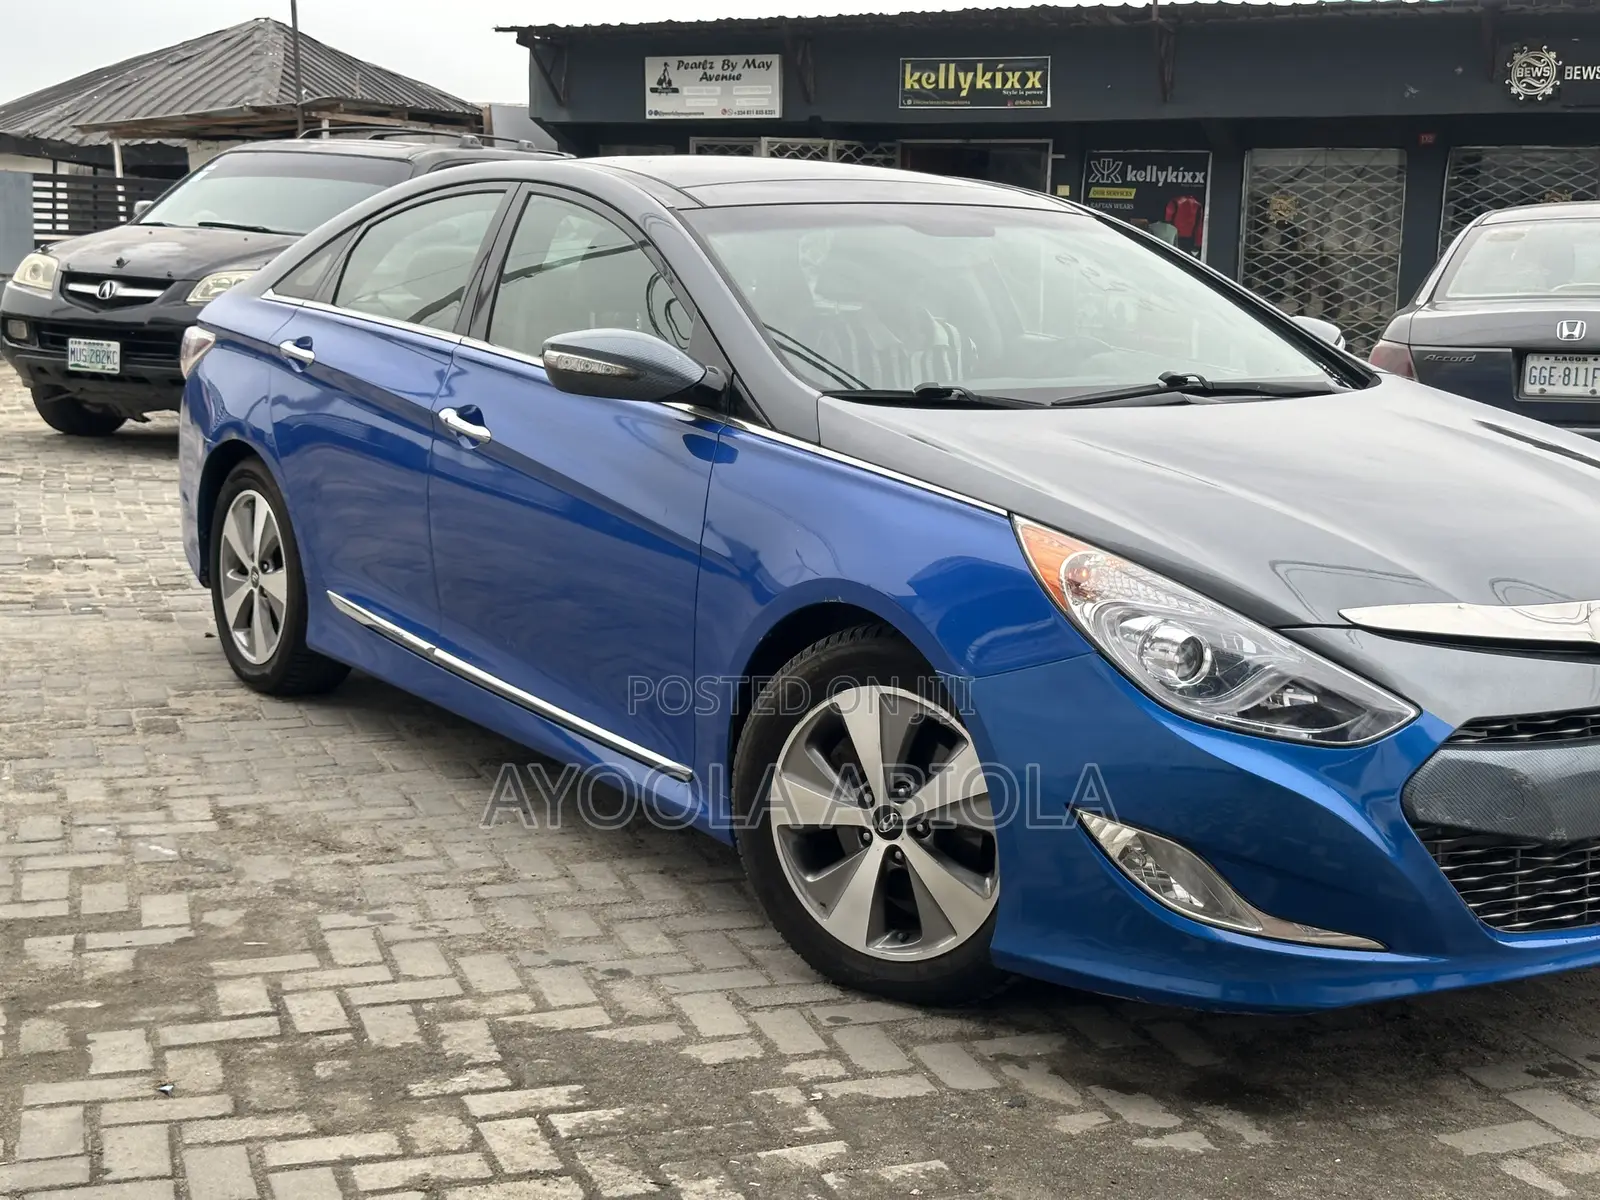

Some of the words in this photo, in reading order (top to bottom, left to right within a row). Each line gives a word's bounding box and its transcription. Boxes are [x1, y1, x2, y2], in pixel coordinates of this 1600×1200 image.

[676, 59, 715, 71] Pearlz
[721, 59, 738, 72] By
[742, 58, 773, 72] May
[699, 71, 742, 82] Avenue
[1516, 67, 1550, 77] BEWS
[904, 62, 1044, 97] kellykixx
[1126, 164, 1206, 187] kellykixx
[1424, 353, 1477, 362] Accord
